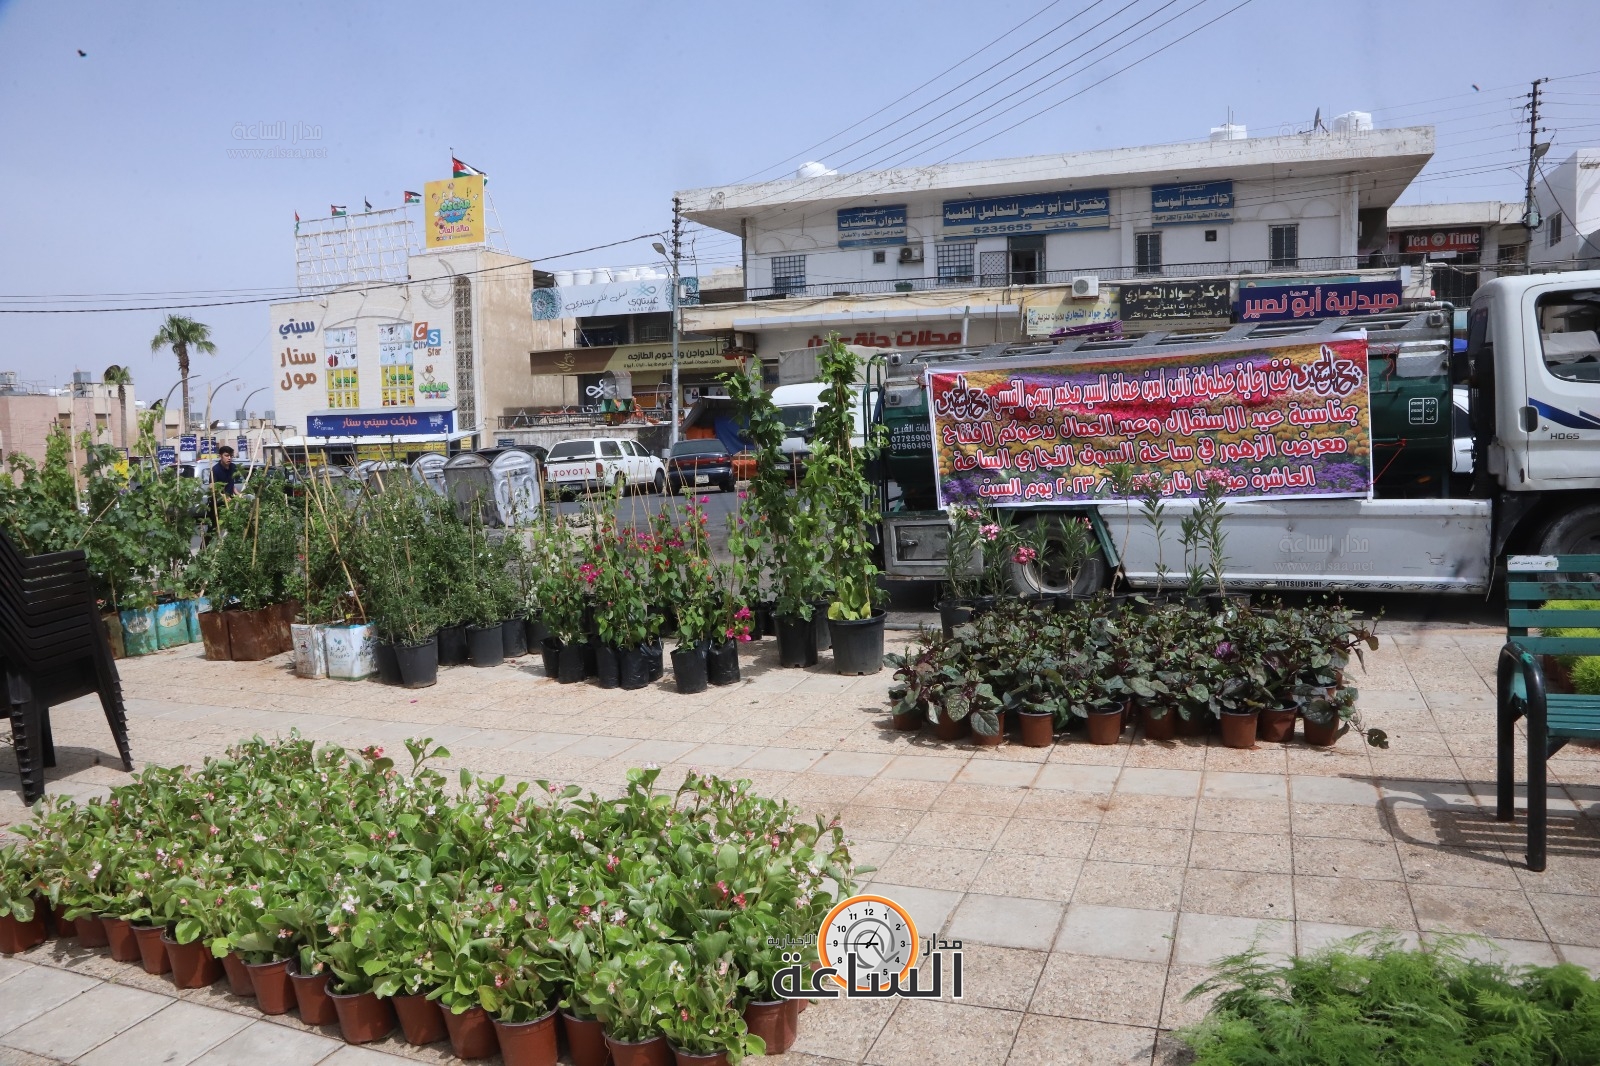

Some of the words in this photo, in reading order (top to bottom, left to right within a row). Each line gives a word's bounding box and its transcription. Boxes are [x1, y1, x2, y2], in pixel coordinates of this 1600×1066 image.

[440, 200, 471, 212] OSCAR
[945, 205, 976, 223] الطبية
[978, 203, 1019, 221] للتحاليل
[1021, 200, 1045, 218] نصير
[1063, 197, 1106, 214] مختبرات
[973, 223, 1033, 234] 5235655
[1406, 235, 1428, 247] Tea
[1448, 232, 1480, 245] Time
[1124, 286, 1166, 304] التجاري
[1169, 287, 1196, 301] جواد
[1197, 284, 1227, 300] مركز
[1291, 287, 1321, 317] أبو
[1243, 294, 1287, 319] نصير
[1325, 290, 1399, 315] صيدلية
[1065, 308, 1087, 322] التجاري
[1088, 309, 1101, 322] جواد
[1103, 308, 1118, 320] مركز
[279, 318, 315, 339] سيتي
[897, 330, 962, 346] محلات
[854, 332, 892, 348] جنة
[281, 347, 316, 367] ستار
[428, 348, 441, 357] Star
[281, 372, 317, 390] مول
[419, 382, 450, 393] OSCAR
[1083, 373, 1109, 408] السيد
[1111, 372, 1140, 402] عمان
[1168, 366, 1191, 403] نائب
[1192, 364, 1235, 400] عطوفة
[1236, 362, 1267, 399] رعاية
[1054, 382, 1082, 405] محمد
[342, 417, 361, 428] ستار
[364, 418, 388, 429] سيتي
[390, 416, 417, 427] ماركت
[1166, 405, 1246, 436] الاستقلال
[1251, 409, 1284, 431] عيد
[1289, 399, 1359, 428] بمناسبة
[942, 420, 995, 446] لافتتاح
[998, 418, 1056, 445] ندعوكم
[1060, 414, 1115, 438] العمال
[1118, 418, 1161, 439] وعيد
[891, 434, 931, 443] 07725900
[892, 442, 932, 450] 07960496
[1219, 434, 1276, 463] الزهور
[1281, 432, 1347, 458] معرض
[953, 448, 1011, 471] الساعة
[1014, 444, 1075, 472] التجاري
[1079, 441, 1135, 468] السوق
[1139, 438, 1193, 463] ساحة
[1197, 436, 1216, 464] في
[554, 468, 591, 477] TOYOTA
[1252, 464, 1316, 491] العاشرة
[978, 477, 1022, 499] السبت
[1024, 481, 1052, 499] يوم
[1276, 580, 1322, 588] MITSUBISHI
